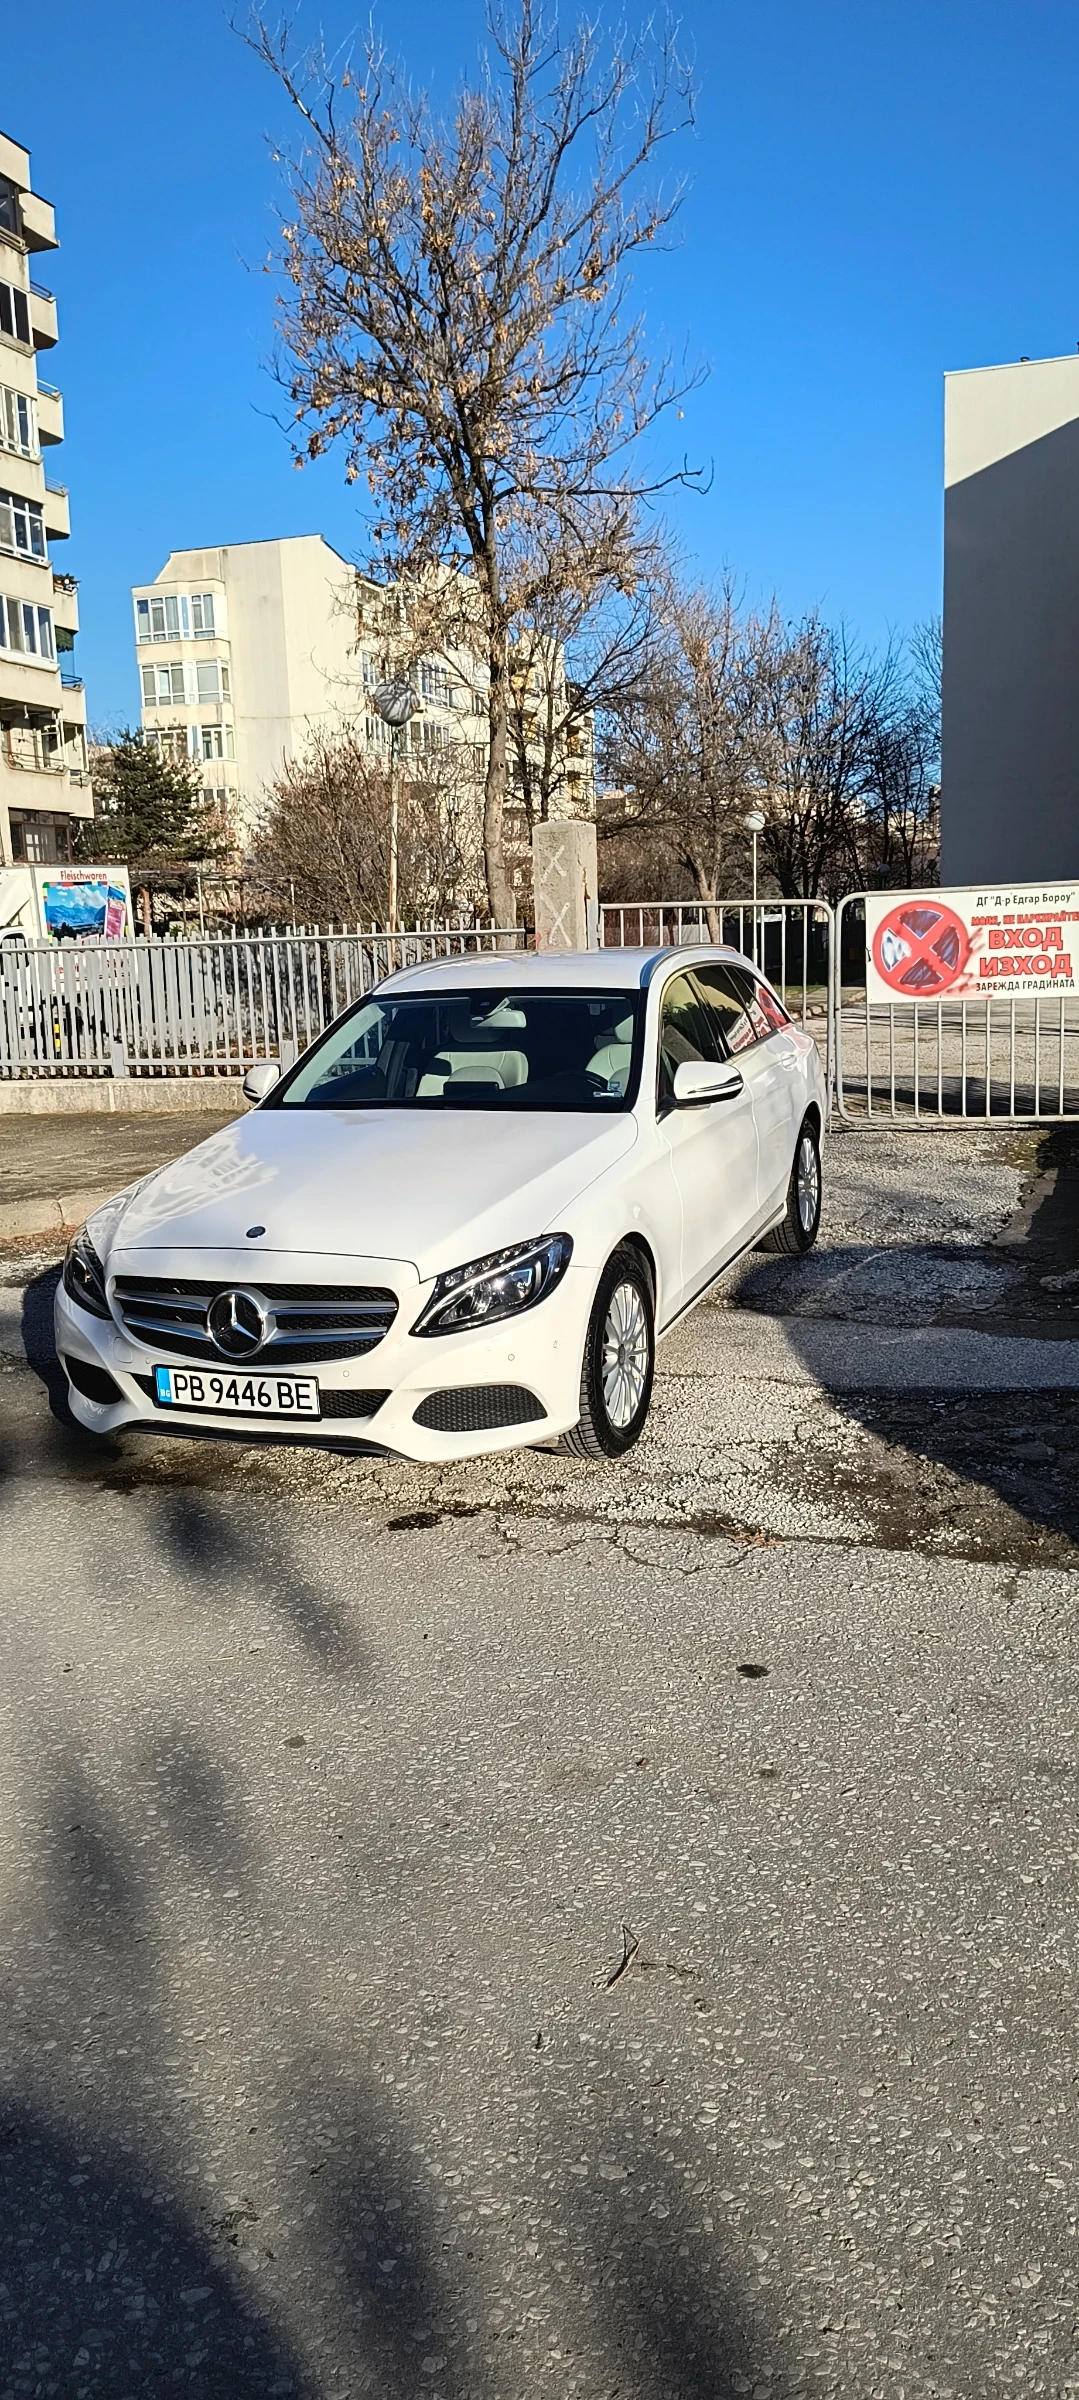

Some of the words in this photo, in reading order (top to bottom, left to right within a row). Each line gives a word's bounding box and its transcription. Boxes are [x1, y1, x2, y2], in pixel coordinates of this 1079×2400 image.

[60, 869, 108, 881] Fleischwaren
[976, 896, 988, 907] ДГ
[1013, 895, 1040, 905] Едгар
[1042, 892, 1075, 904] Бороу"
[988, 926, 1063, 951] ВХОД
[979, 953, 1073, 978] ИЗХОД
[975, 981, 1020, 992] ЗАРЕЖДА
[1022, 979, 1075, 990] ГРАДИНАТА
[160, 1388, 171, 1398] BG
[173, 1373, 205, 1402] PB
[209, 1377, 272, 1408] 9446
[276, 1381, 313, 1411] BE
